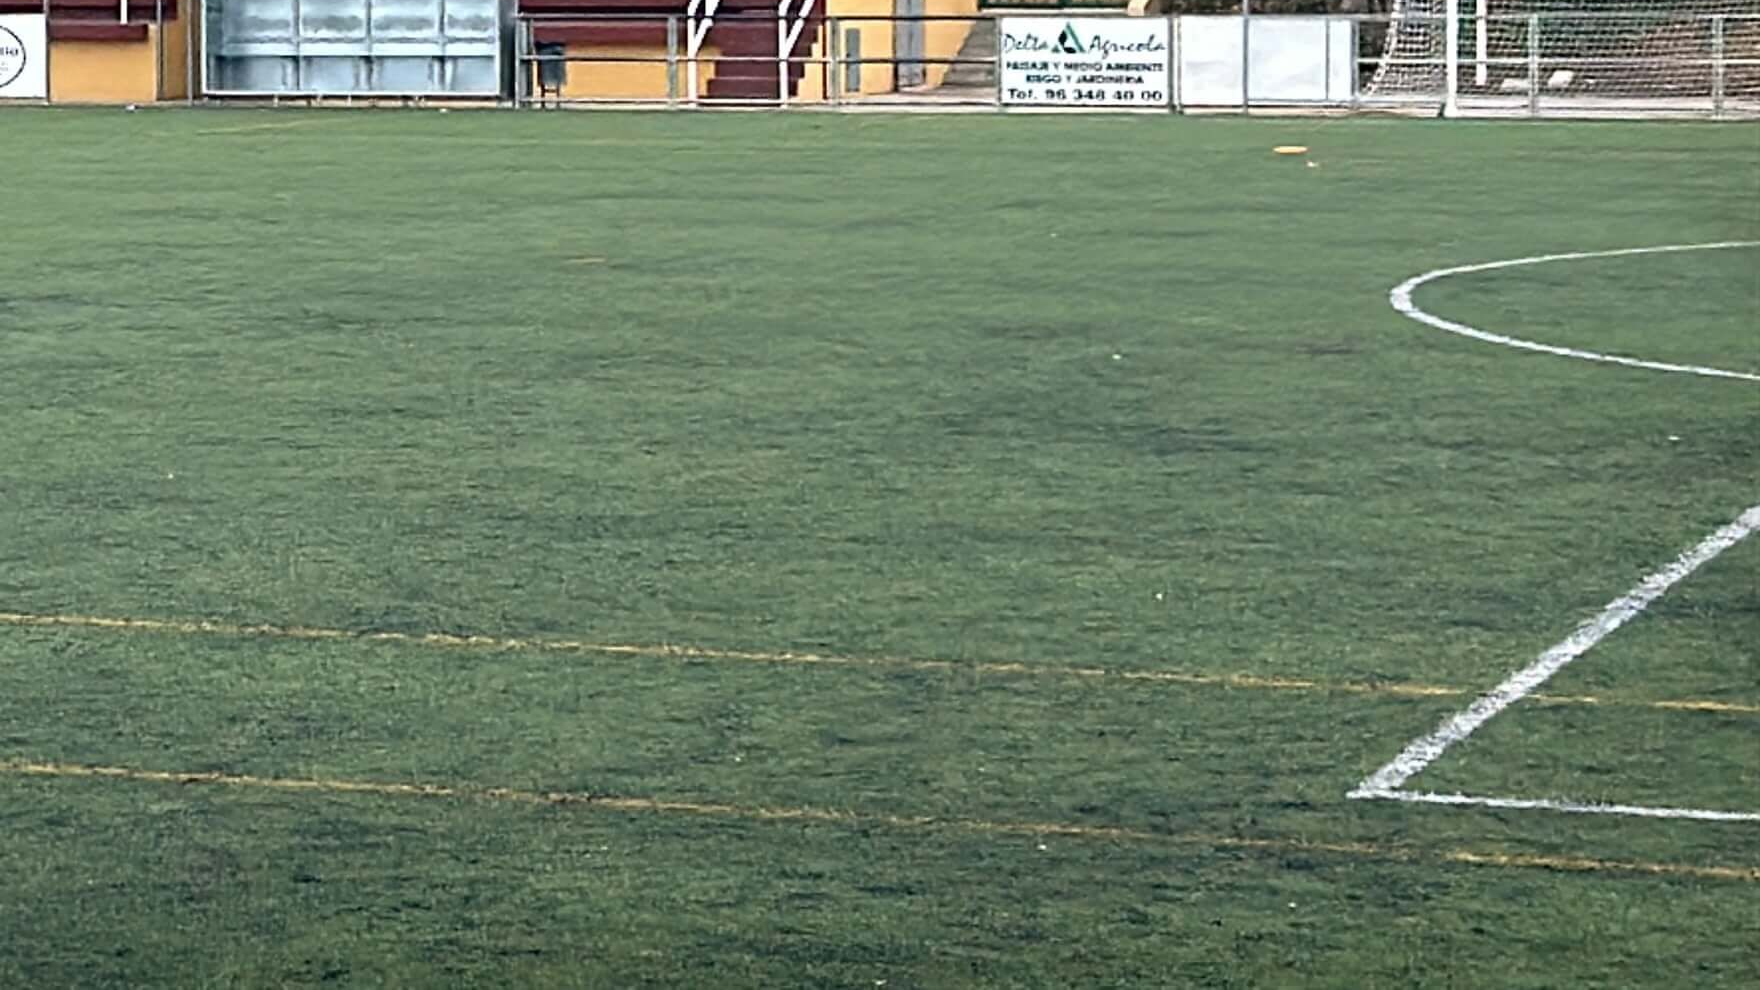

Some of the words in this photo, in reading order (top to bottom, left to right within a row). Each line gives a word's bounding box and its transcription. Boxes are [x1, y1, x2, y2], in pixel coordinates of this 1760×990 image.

[1003, 33, 1049, 53] Delta
[1064, 62, 1103, 72] MEDIO
[1106, 62, 1164, 72] AMBIENTE
[1046, 89, 1067, 100] 96
[1073, 89, 1105, 100] 348
[1112, 89, 1135, 100] 40
[1141, 89, 1163, 100] 00
